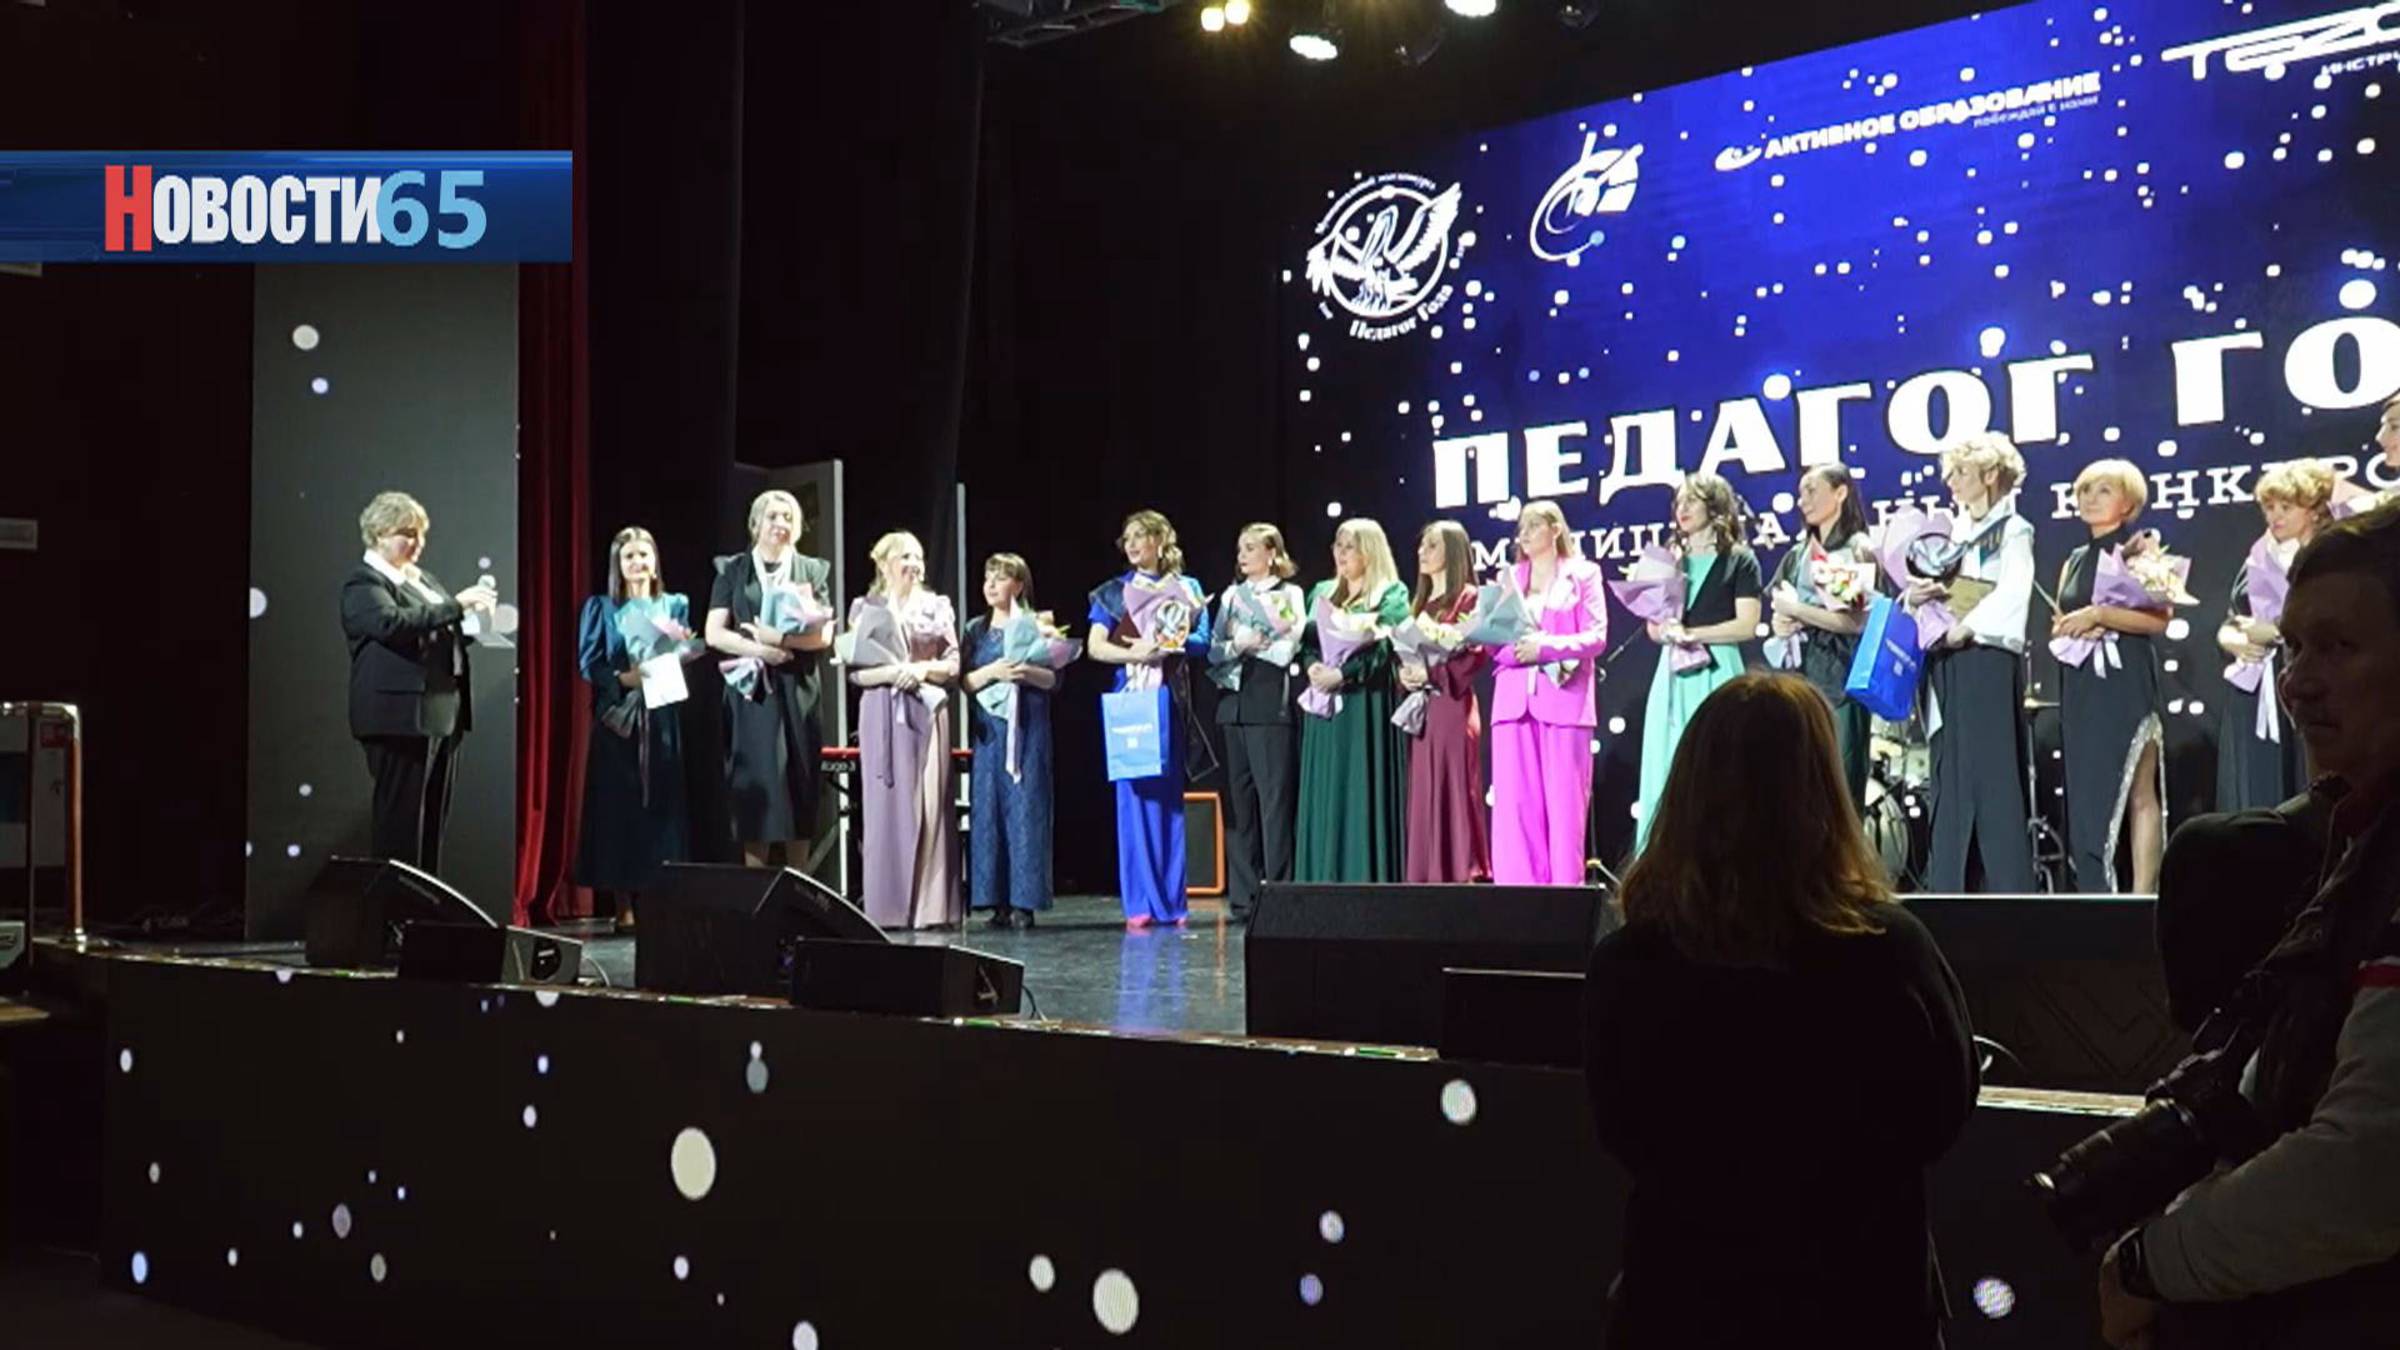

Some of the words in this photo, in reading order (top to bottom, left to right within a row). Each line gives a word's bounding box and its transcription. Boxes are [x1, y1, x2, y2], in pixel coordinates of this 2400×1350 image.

[1764, 114, 1896, 159] АКТИВНОЕ
[1900, 71, 2101, 131] ОБРАЗОВАНИЕ
[1432, 350, 2094, 510] ПЕДАГОГ
